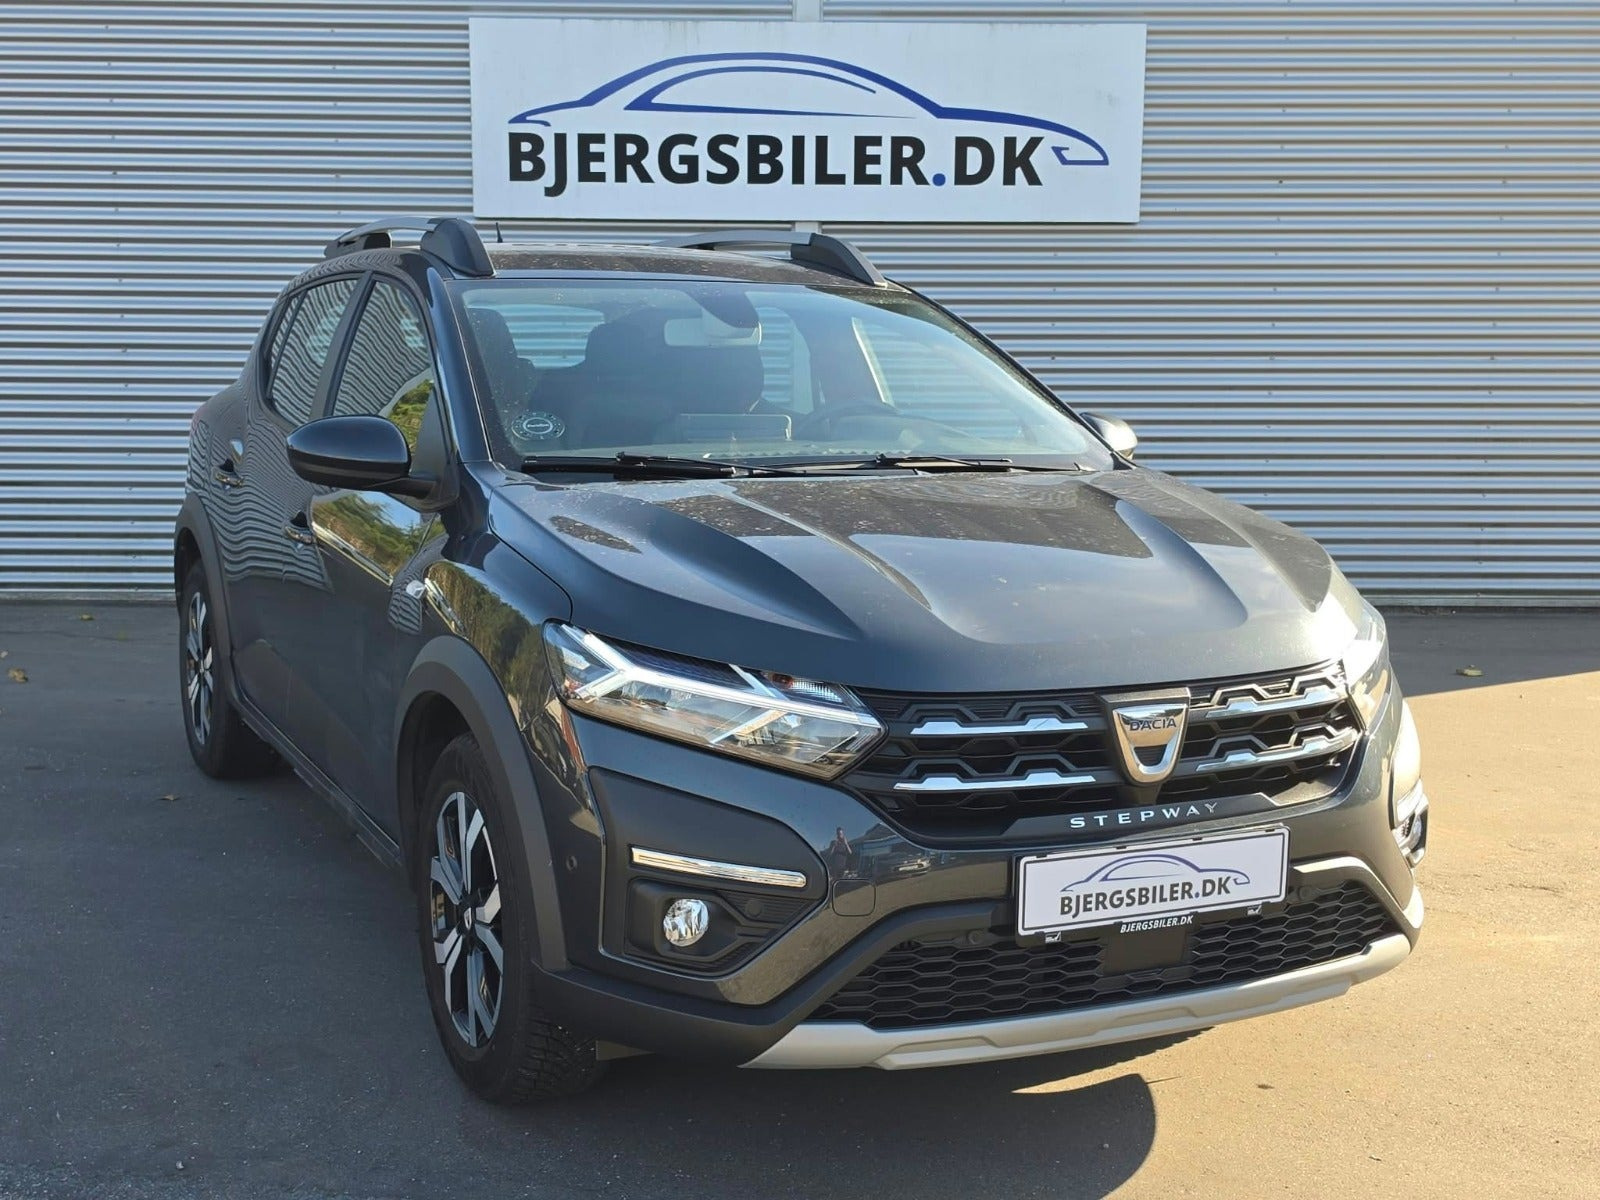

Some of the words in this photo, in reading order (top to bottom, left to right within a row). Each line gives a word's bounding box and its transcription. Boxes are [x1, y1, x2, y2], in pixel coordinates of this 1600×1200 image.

[508, 131, 1045, 197] BJERGSBILER.DK
[1129, 718, 1177, 731] DACIA
[1070, 802, 1218, 828] STEPWAY
[1060, 876, 1231, 918] BJERGSBILER.DK
[1120, 915, 1194, 933] BJERGSBILER.DK
